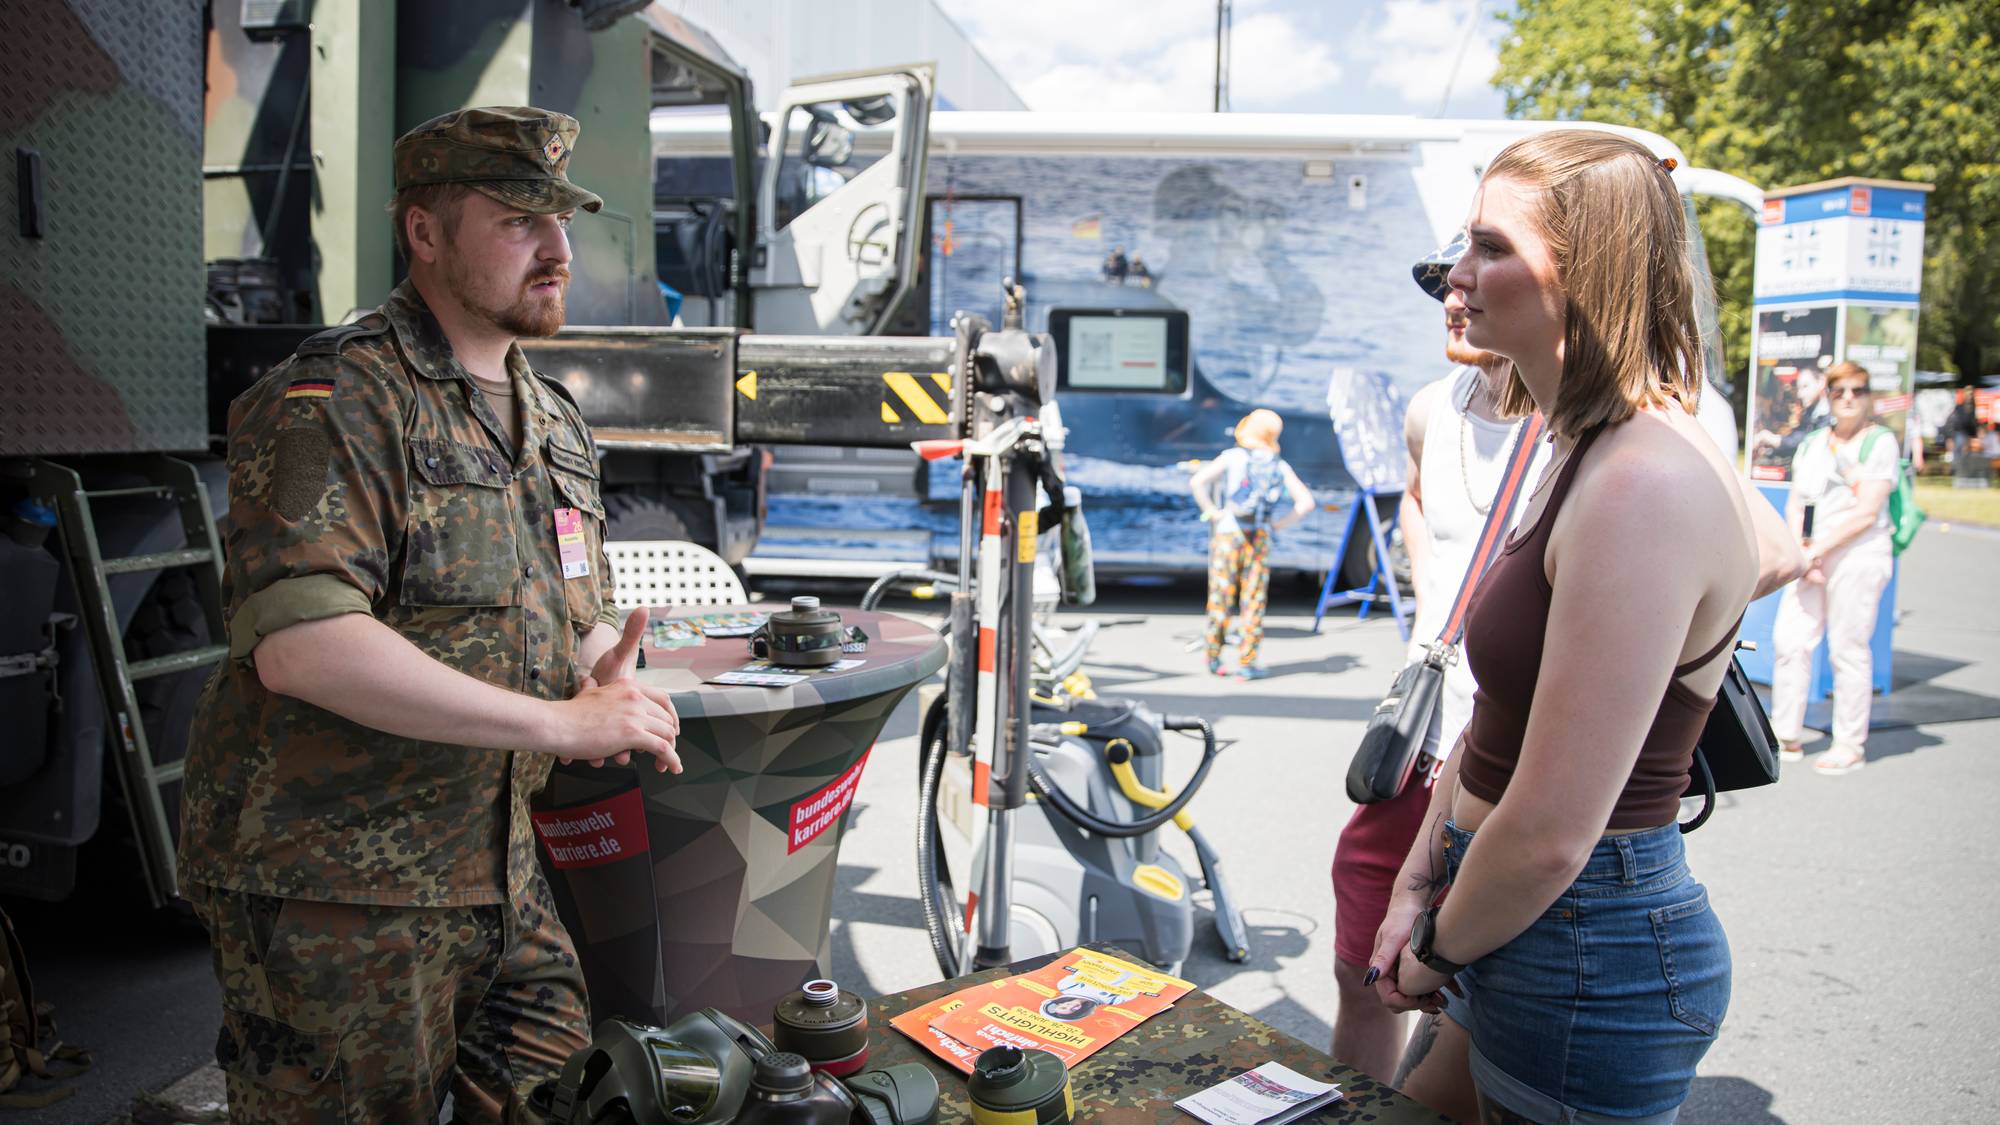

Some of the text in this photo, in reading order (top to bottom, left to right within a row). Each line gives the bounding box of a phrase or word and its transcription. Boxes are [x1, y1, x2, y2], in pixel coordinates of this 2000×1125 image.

[535, 811, 615, 837] bundeswehr
[548, 835, 621, 862] karriere.de
[982, 1023, 1039, 1048] einfach!
[988, 1006, 1085, 1045] HIGHLIGHTS
